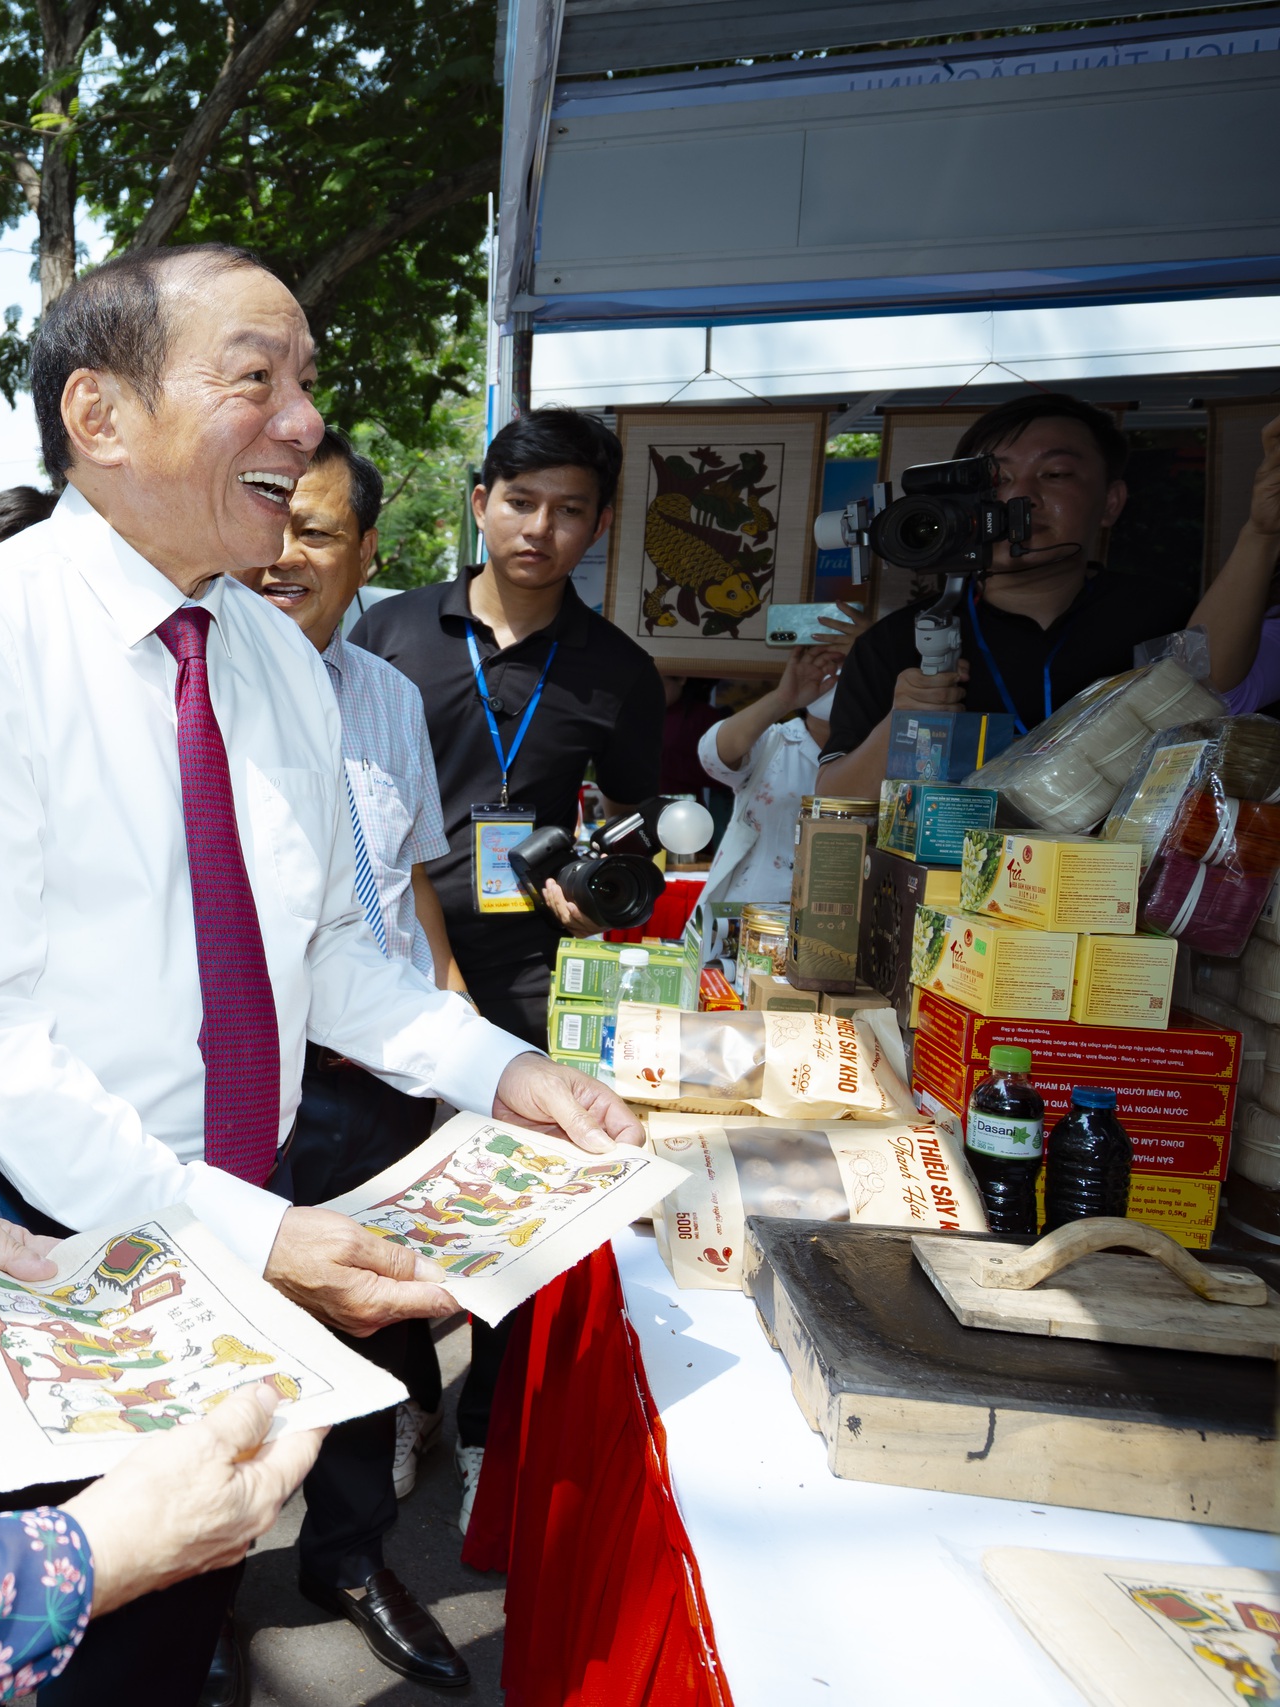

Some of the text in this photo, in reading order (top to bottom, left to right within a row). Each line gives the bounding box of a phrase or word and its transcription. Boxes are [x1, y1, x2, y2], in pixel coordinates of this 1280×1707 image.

[1007, 858, 1026, 888] Trà
[950, 940, 966, 969] Trà
[799, 1064, 812, 1096] OCOP
[1034, 1081, 1058, 1090] PHẨM
[1060, 1082, 1071, 1091] ĐÃ
[1117, 1086, 1145, 1096] NGƯỜI
[1146, 1087, 1165, 1097] MẾN
[1050, 1099, 1068, 1108] QUÀ
[1122, 1104, 1133, 1113] VÀ
[1135, 1104, 1162, 1114] NGOÀI
[1163, 1106, 1189, 1116] NƯỚC
[977, 1120, 1016, 1137] Dasani
[1141, 1138, 1158, 1147] LÀM
[1160, 1139, 1185, 1149] DÙNG
[1157, 1156, 1174, 1165] SẢN
[1127, 1206, 1143, 1214] rọng
[676, 1212, 693, 1240] 500G
